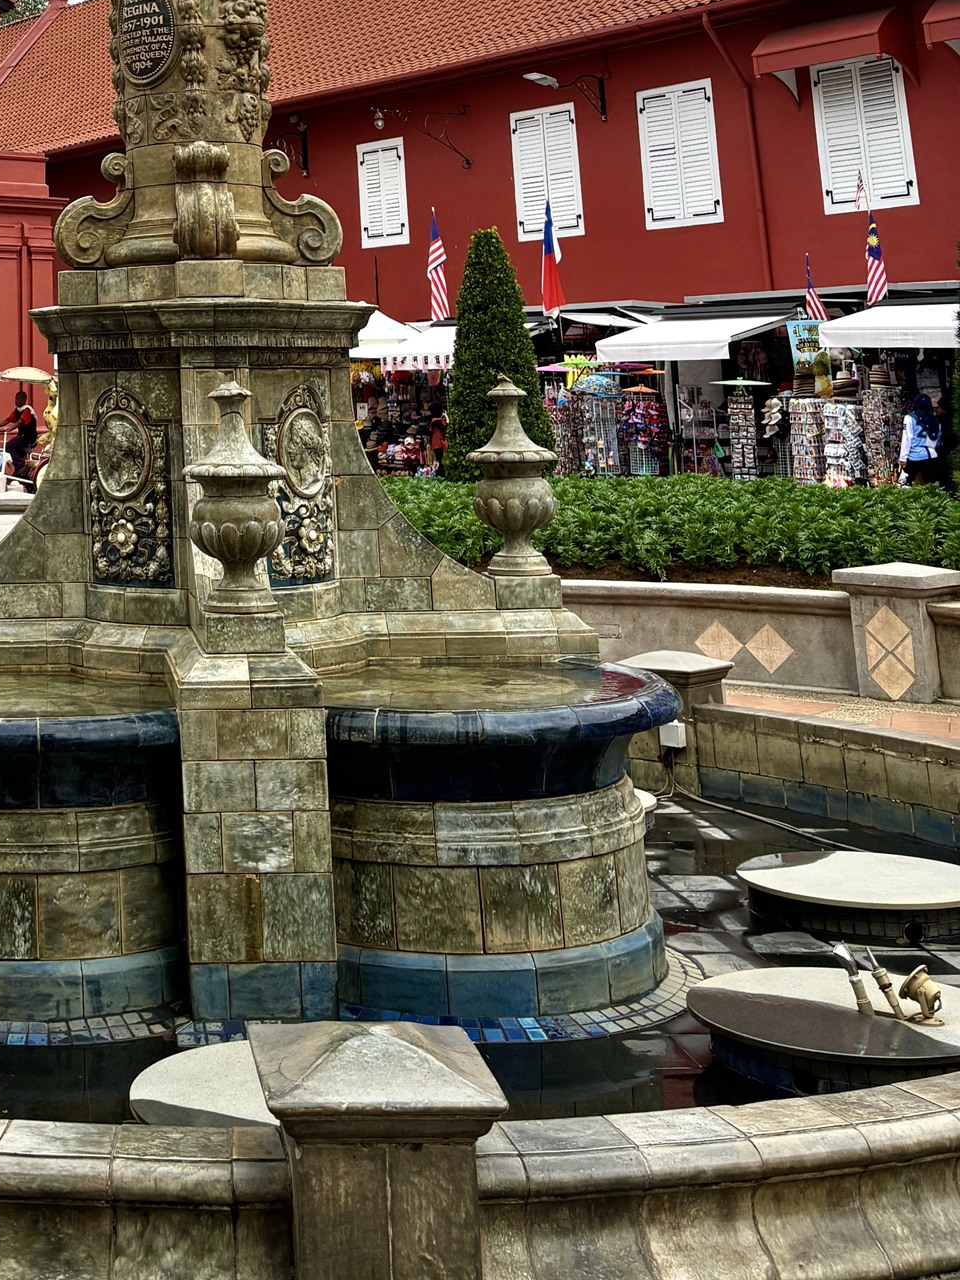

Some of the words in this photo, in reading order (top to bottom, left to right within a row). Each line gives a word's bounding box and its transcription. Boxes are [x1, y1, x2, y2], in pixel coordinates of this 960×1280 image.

[122, 2, 160, 19] REGINA
[153, 26, 170, 35] THE
[132, 59, 153, 74] 1904
